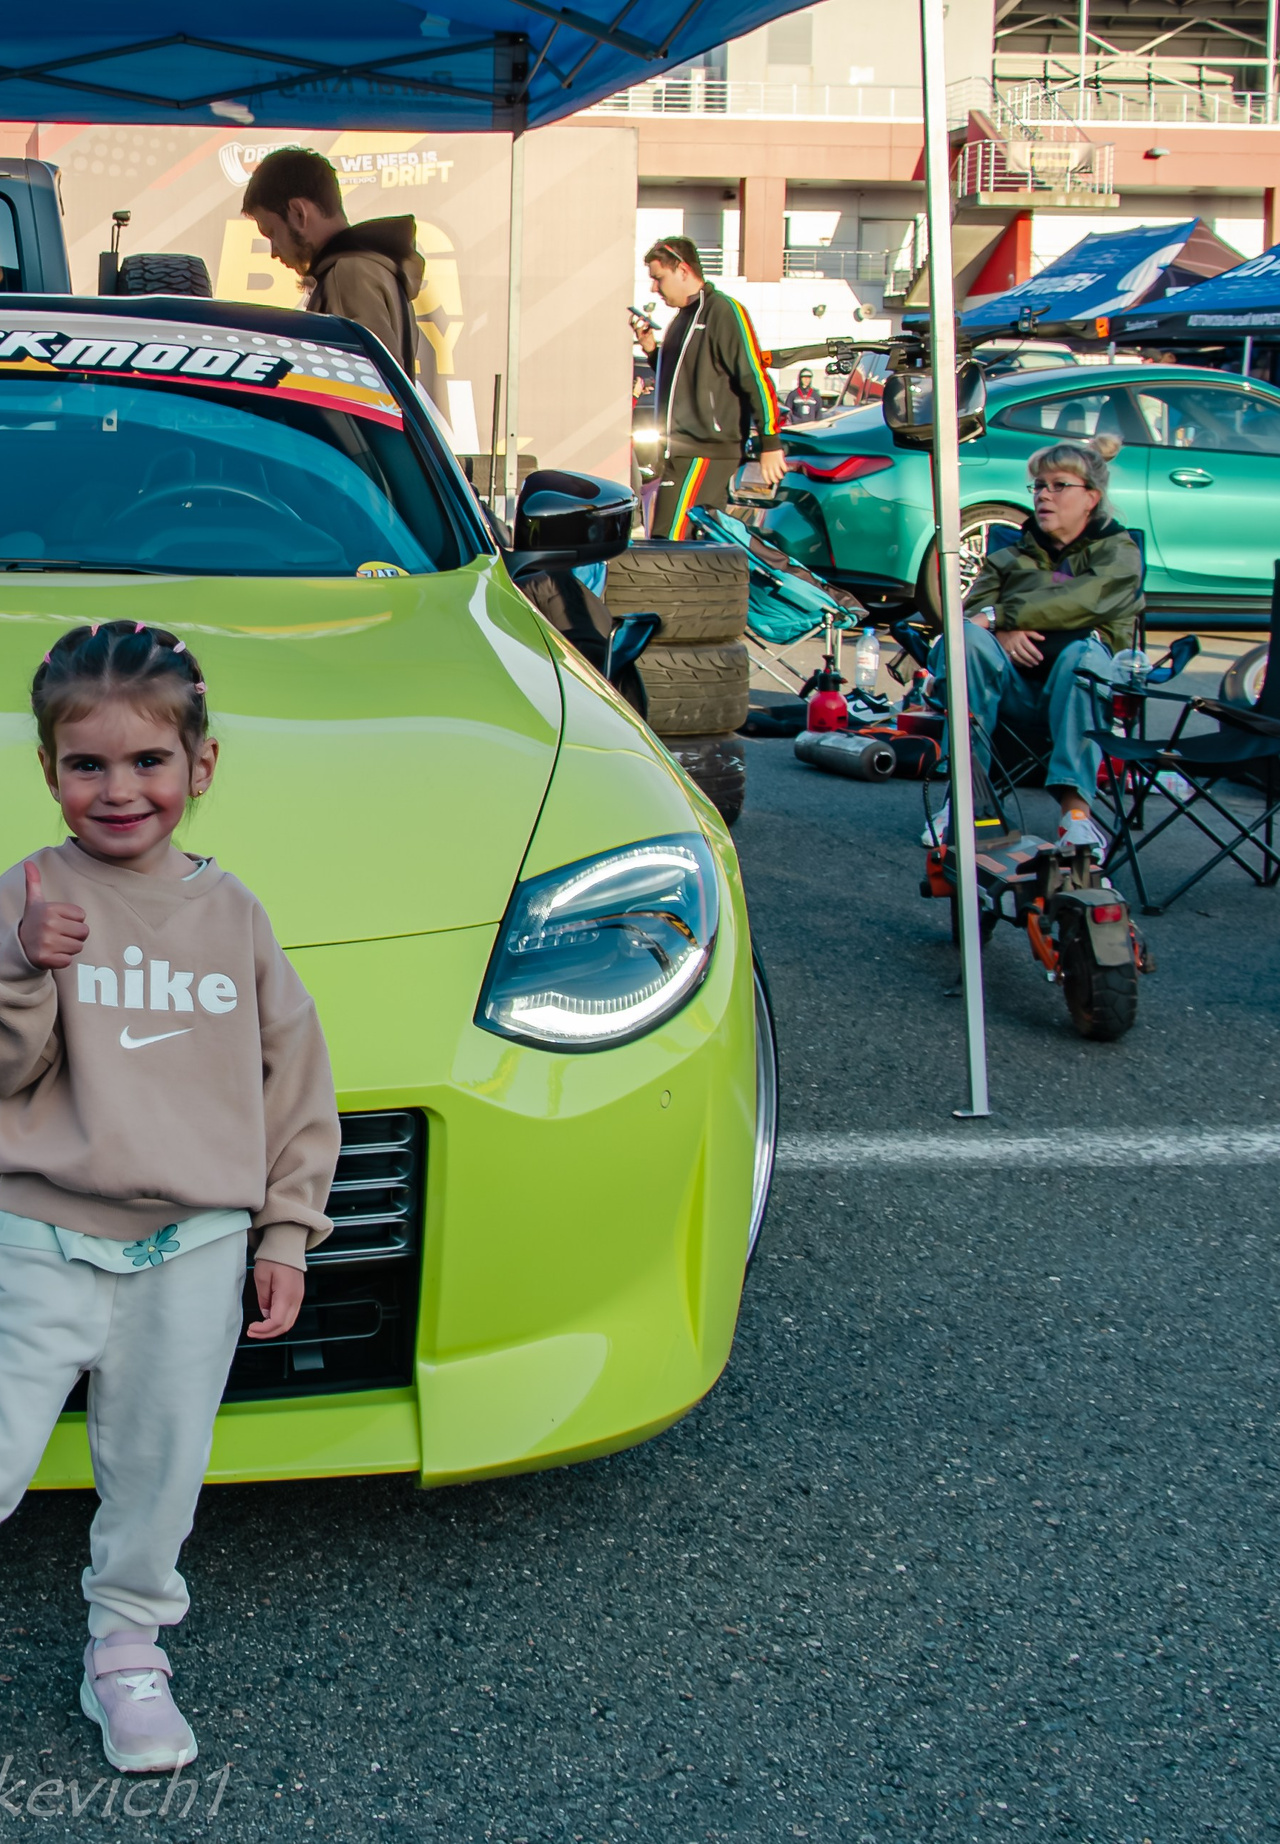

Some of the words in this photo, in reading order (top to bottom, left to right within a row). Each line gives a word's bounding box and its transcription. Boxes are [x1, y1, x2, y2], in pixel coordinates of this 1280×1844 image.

[341, 154, 373, 172] WE
[376, 152, 419, 170] NEED
[422, 150, 438, 163] IS
[381, 160, 454, 189] DRIFT
[51, 338, 281, 382] MODE
[77, 945, 238, 1014] nike
